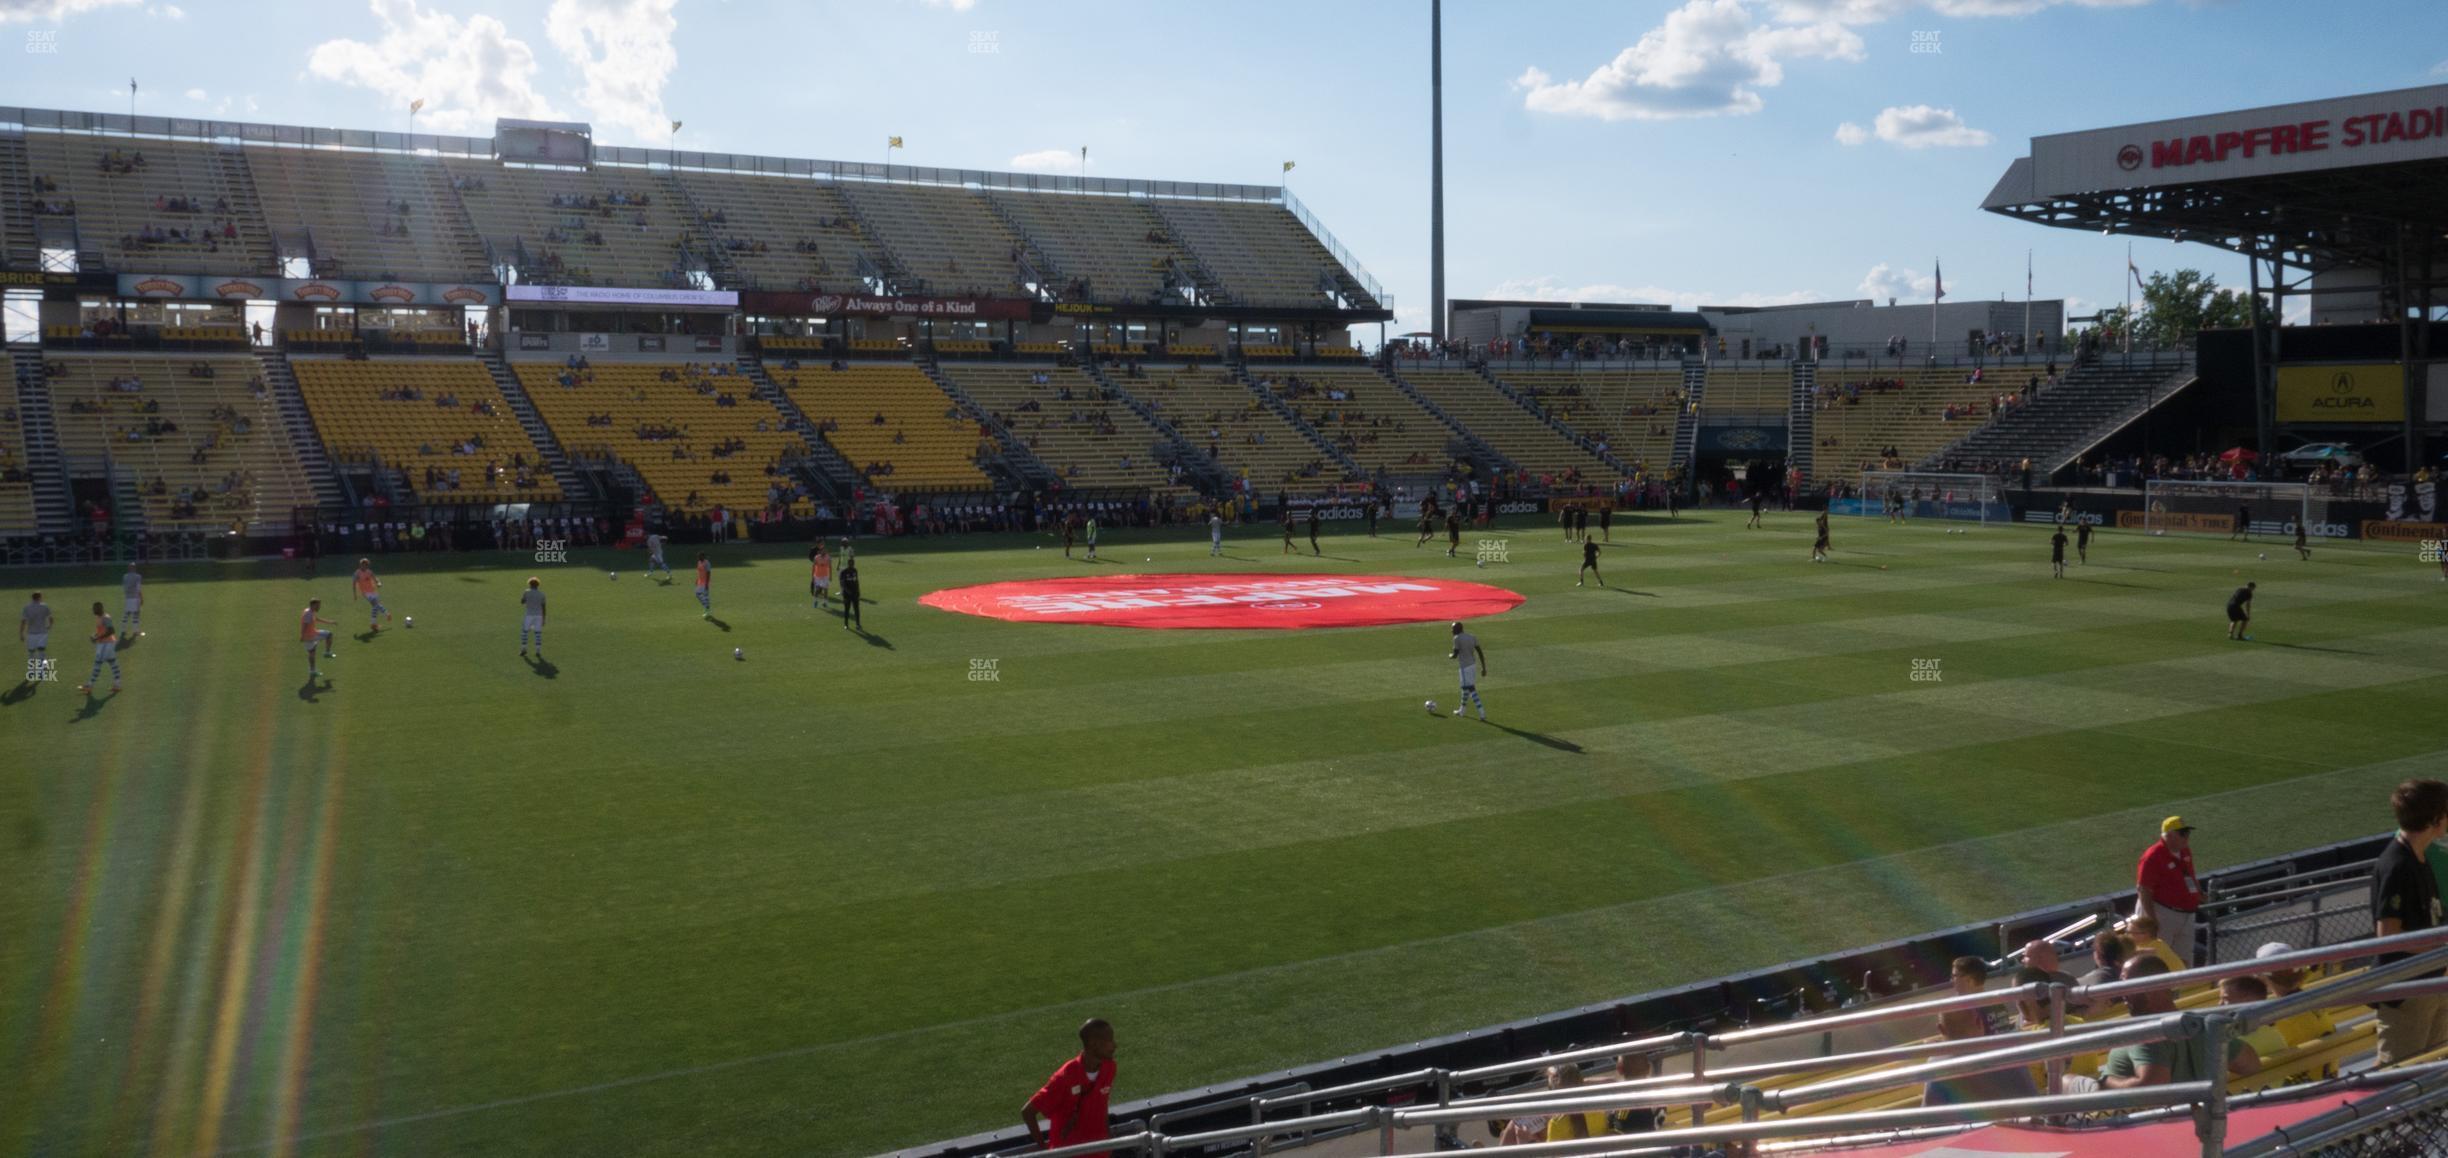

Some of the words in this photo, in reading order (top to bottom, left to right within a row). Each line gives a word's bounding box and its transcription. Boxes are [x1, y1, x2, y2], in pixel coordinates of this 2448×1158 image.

[2151, 120, 2329, 169] MAPFRE
[846, 298, 892, 313] Always
[895, 300, 919, 312] One
[921, 300, 934, 313] of
[935, 304, 944, 313] a
[946, 302, 976, 314] Kind
[2312, 397, 2375, 408] ACURA
[1317, 507, 1364, 520] adidas
[1499, 501, 1538, 513] adidas
[2120, 512, 2188, 528] Contnental
[1012, 583, 1440, 614] MAPFRE
